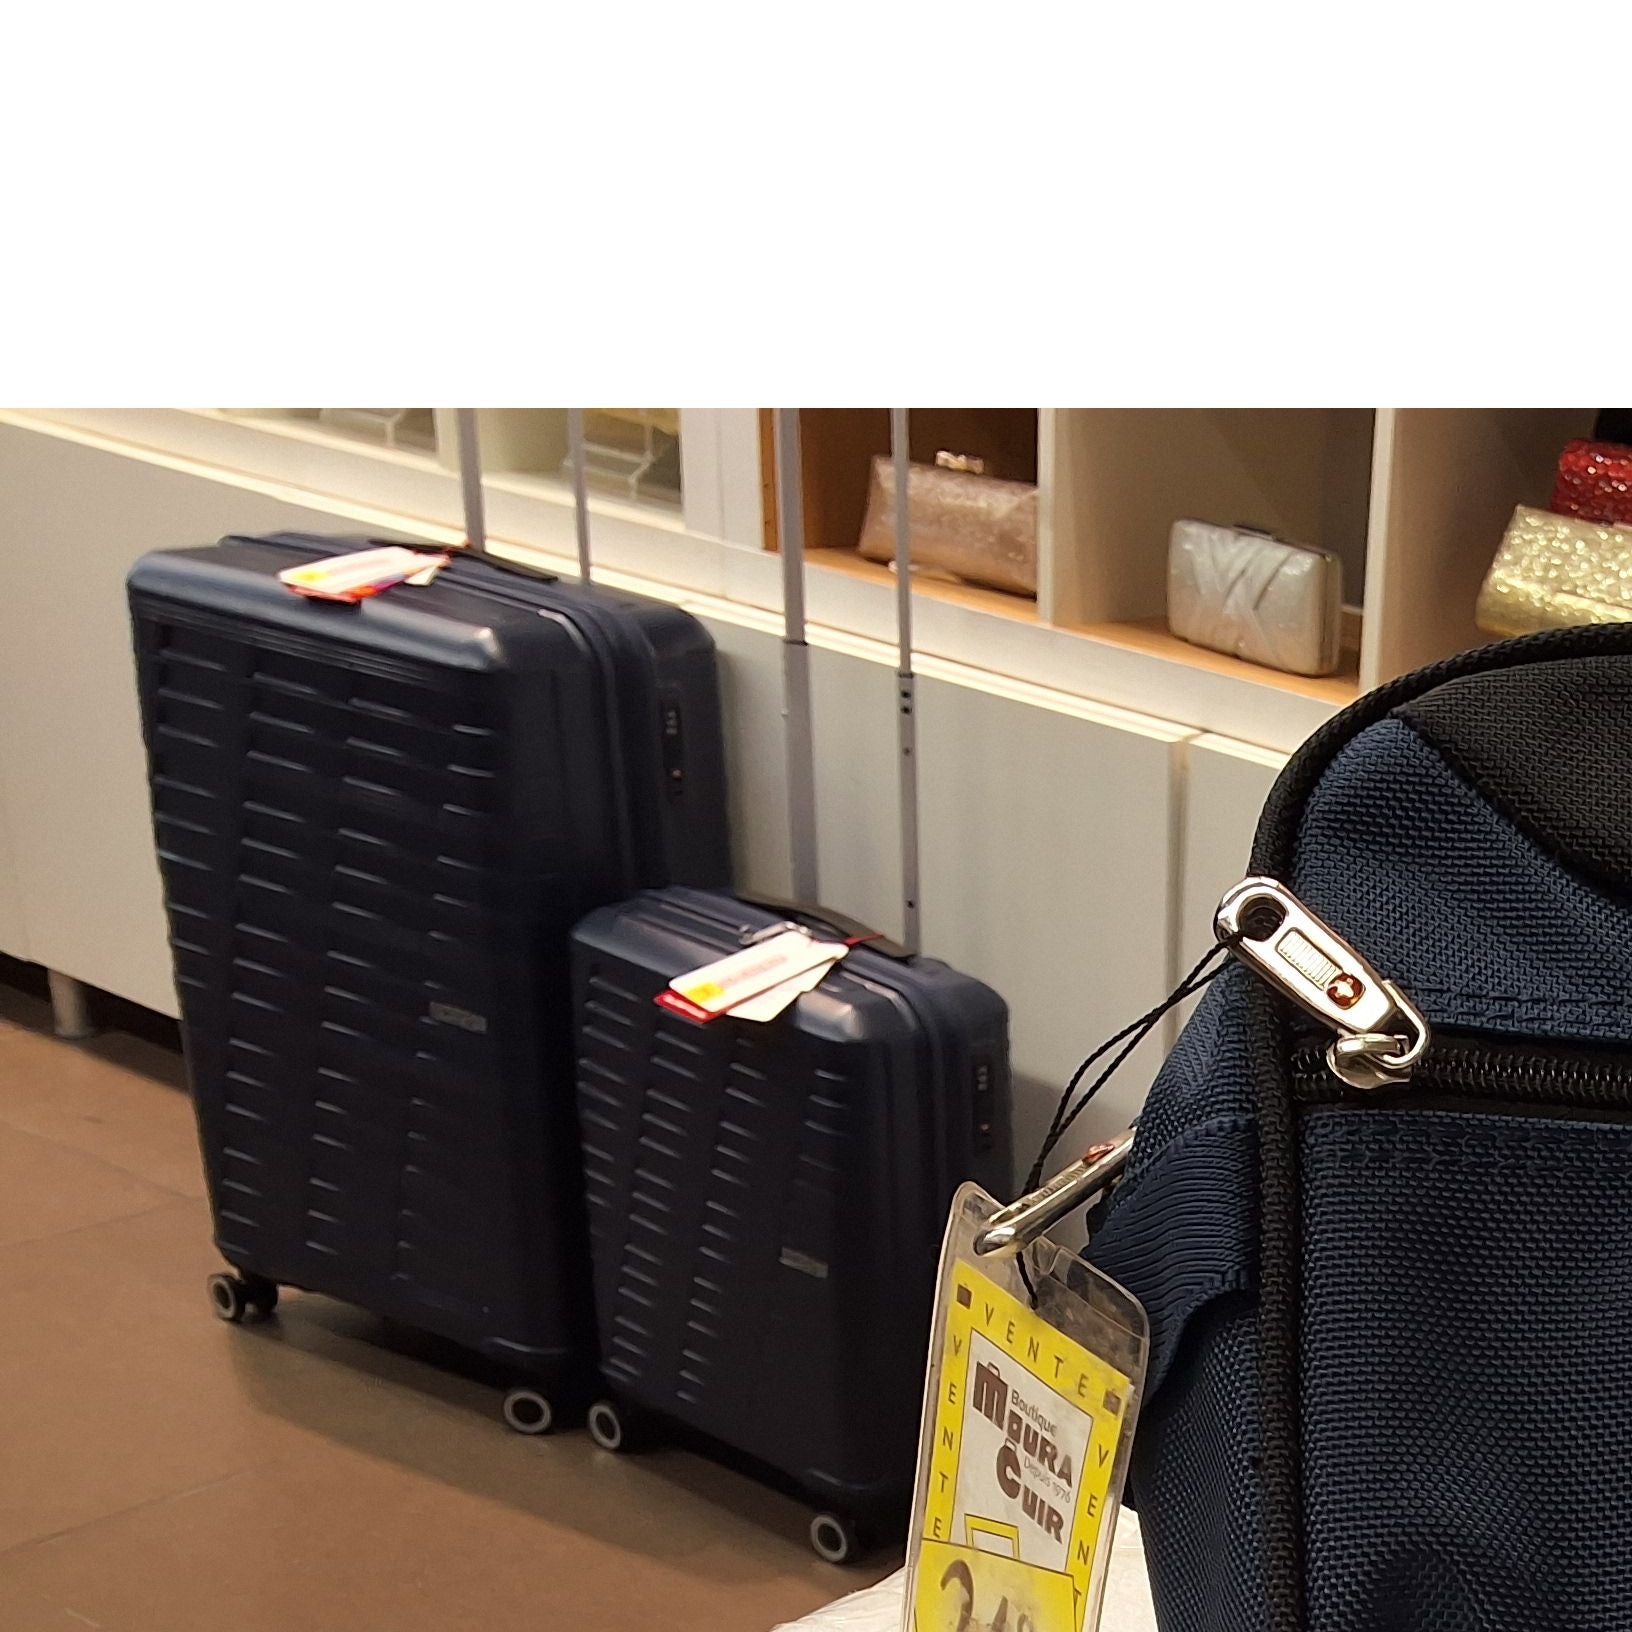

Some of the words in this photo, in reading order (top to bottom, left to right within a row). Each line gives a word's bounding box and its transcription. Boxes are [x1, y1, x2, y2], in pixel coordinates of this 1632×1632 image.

[984, 1302, 1089, 1398] VENTE
[931, 1335, 963, 1540] VENTE
[1011, 1388, 1058, 1437] Boutique
